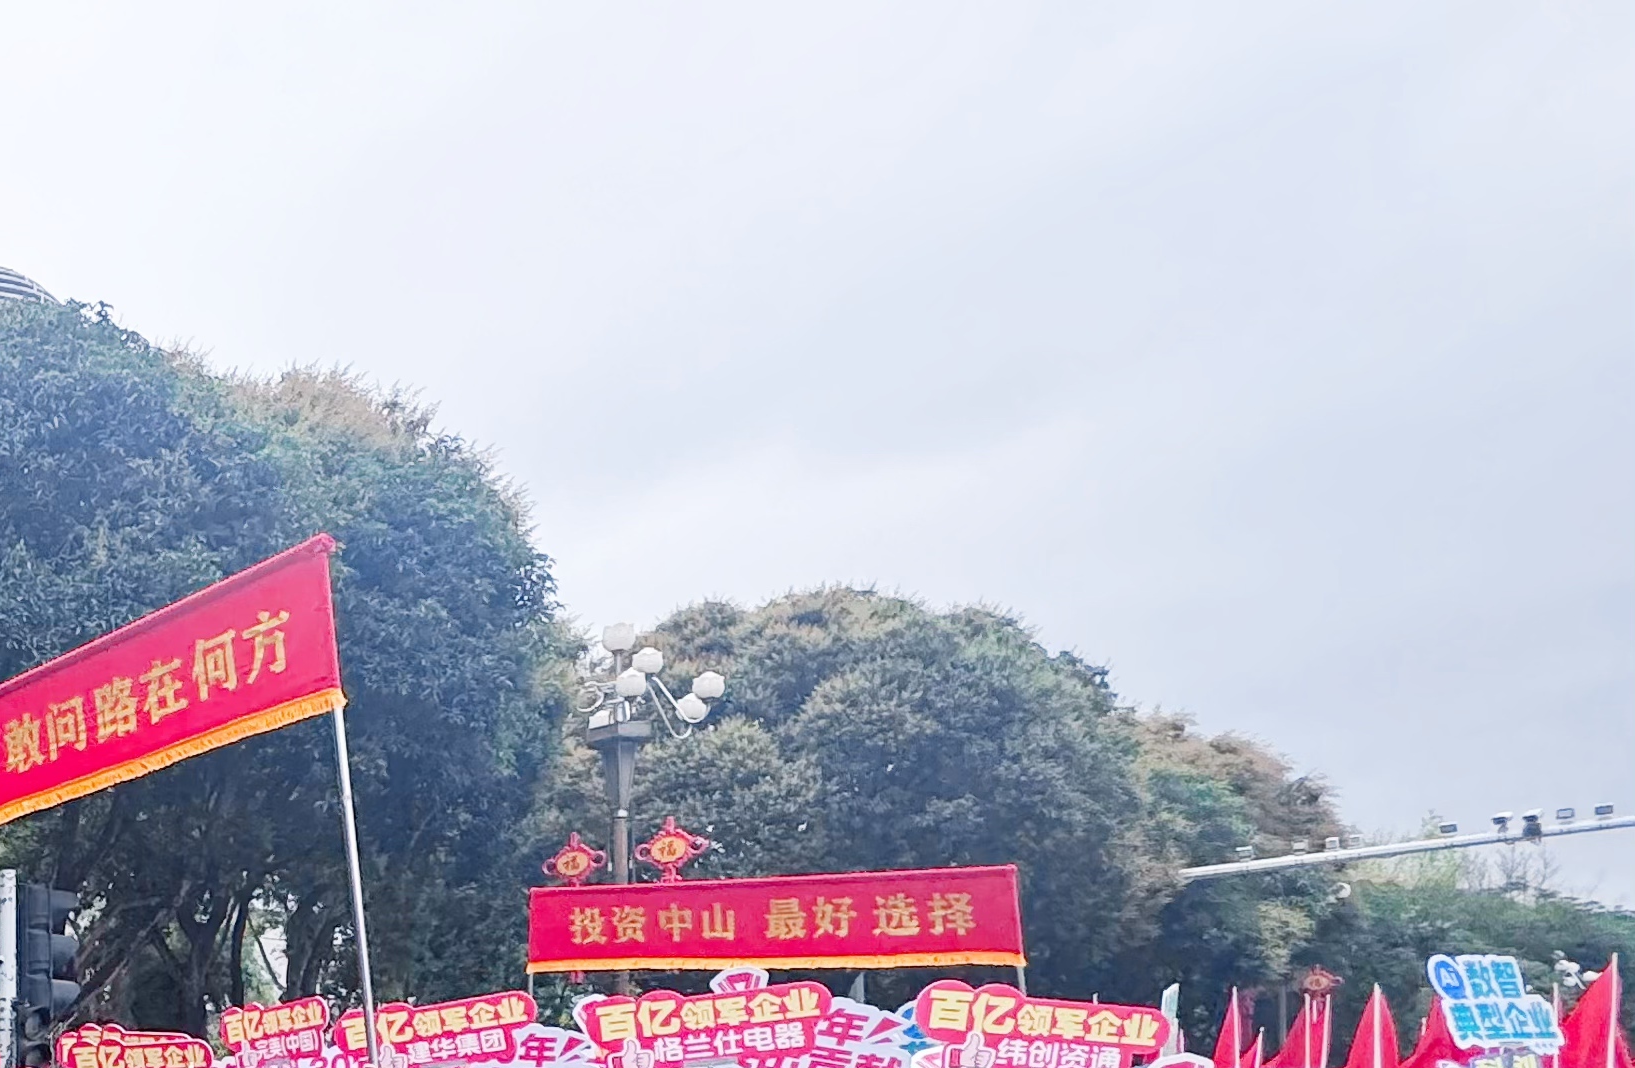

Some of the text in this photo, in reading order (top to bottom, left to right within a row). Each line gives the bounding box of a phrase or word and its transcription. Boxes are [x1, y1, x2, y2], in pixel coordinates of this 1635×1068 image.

[3, 609, 290, 774] 敢问路在何方
[568, 902, 736, 945] 投资中山
[1464, 960, 1522, 998] 数智
[224, 1001, 324, 1044] 百亿领军企业
[342, 996, 528, 1050] 百亿领军企业
[596, 987, 821, 1042] 百亿领军企业
[928, 989, 1160, 1046] 百亿领军企业
[1449, 1002, 1559, 1040] 典型企业
[406, 1028, 507, 1064] 建华集团
[654, 1022, 806, 1063] 格兰仕电器
